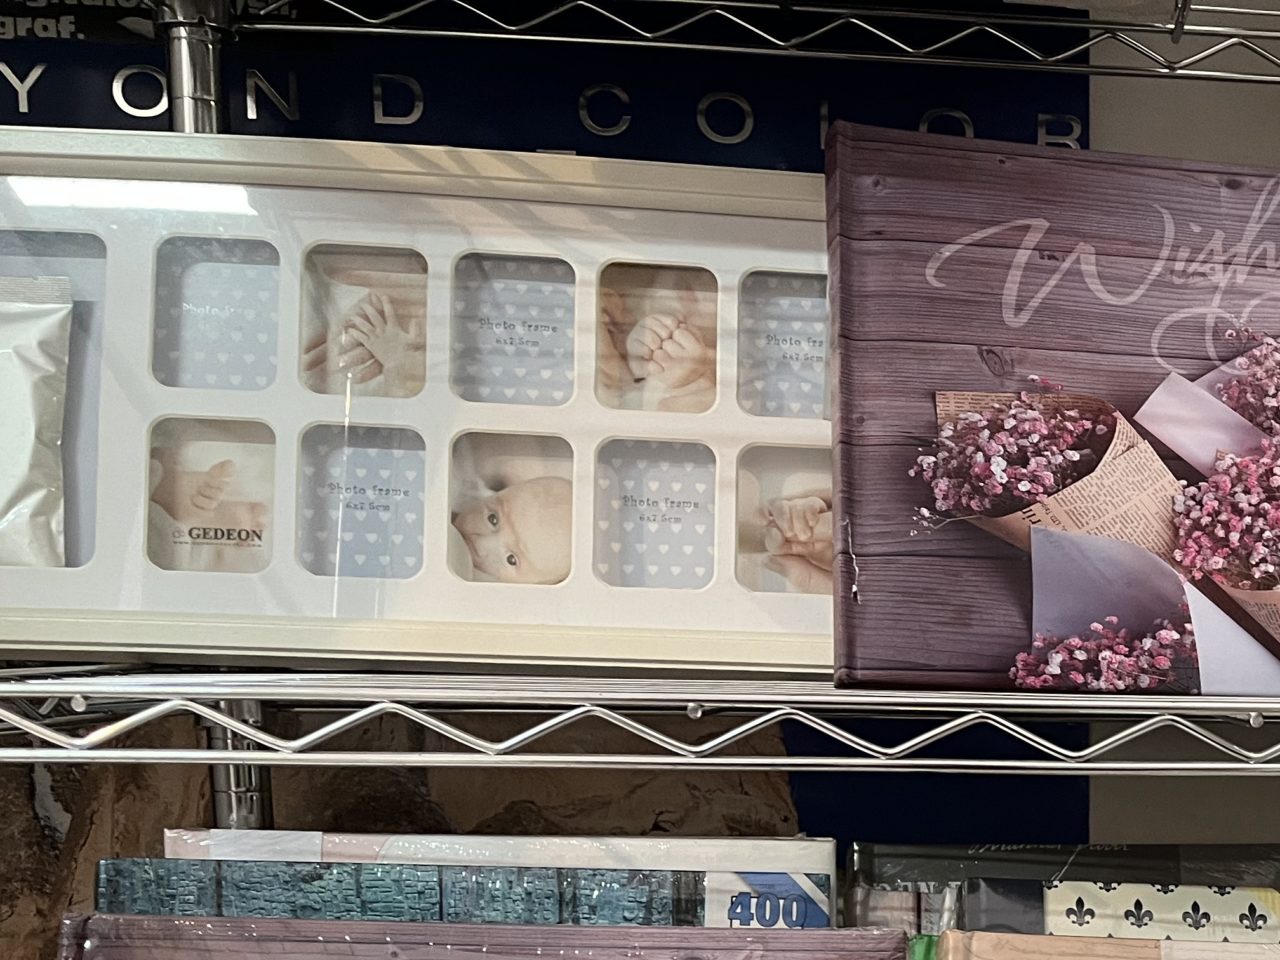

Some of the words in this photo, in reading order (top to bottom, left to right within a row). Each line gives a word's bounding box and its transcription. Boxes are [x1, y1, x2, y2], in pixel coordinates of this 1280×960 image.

[478, 317, 516, 332] Photo
[766, 333, 801, 347] Photo
[328, 481, 366, 496] Photo
[371, 484, 411, 498] frame
[623, 494, 659, 509] Photo
[663, 497, 700, 509] frame
[188, 527, 263, 542] GEDEON
[728, 892, 808, 928] 400
